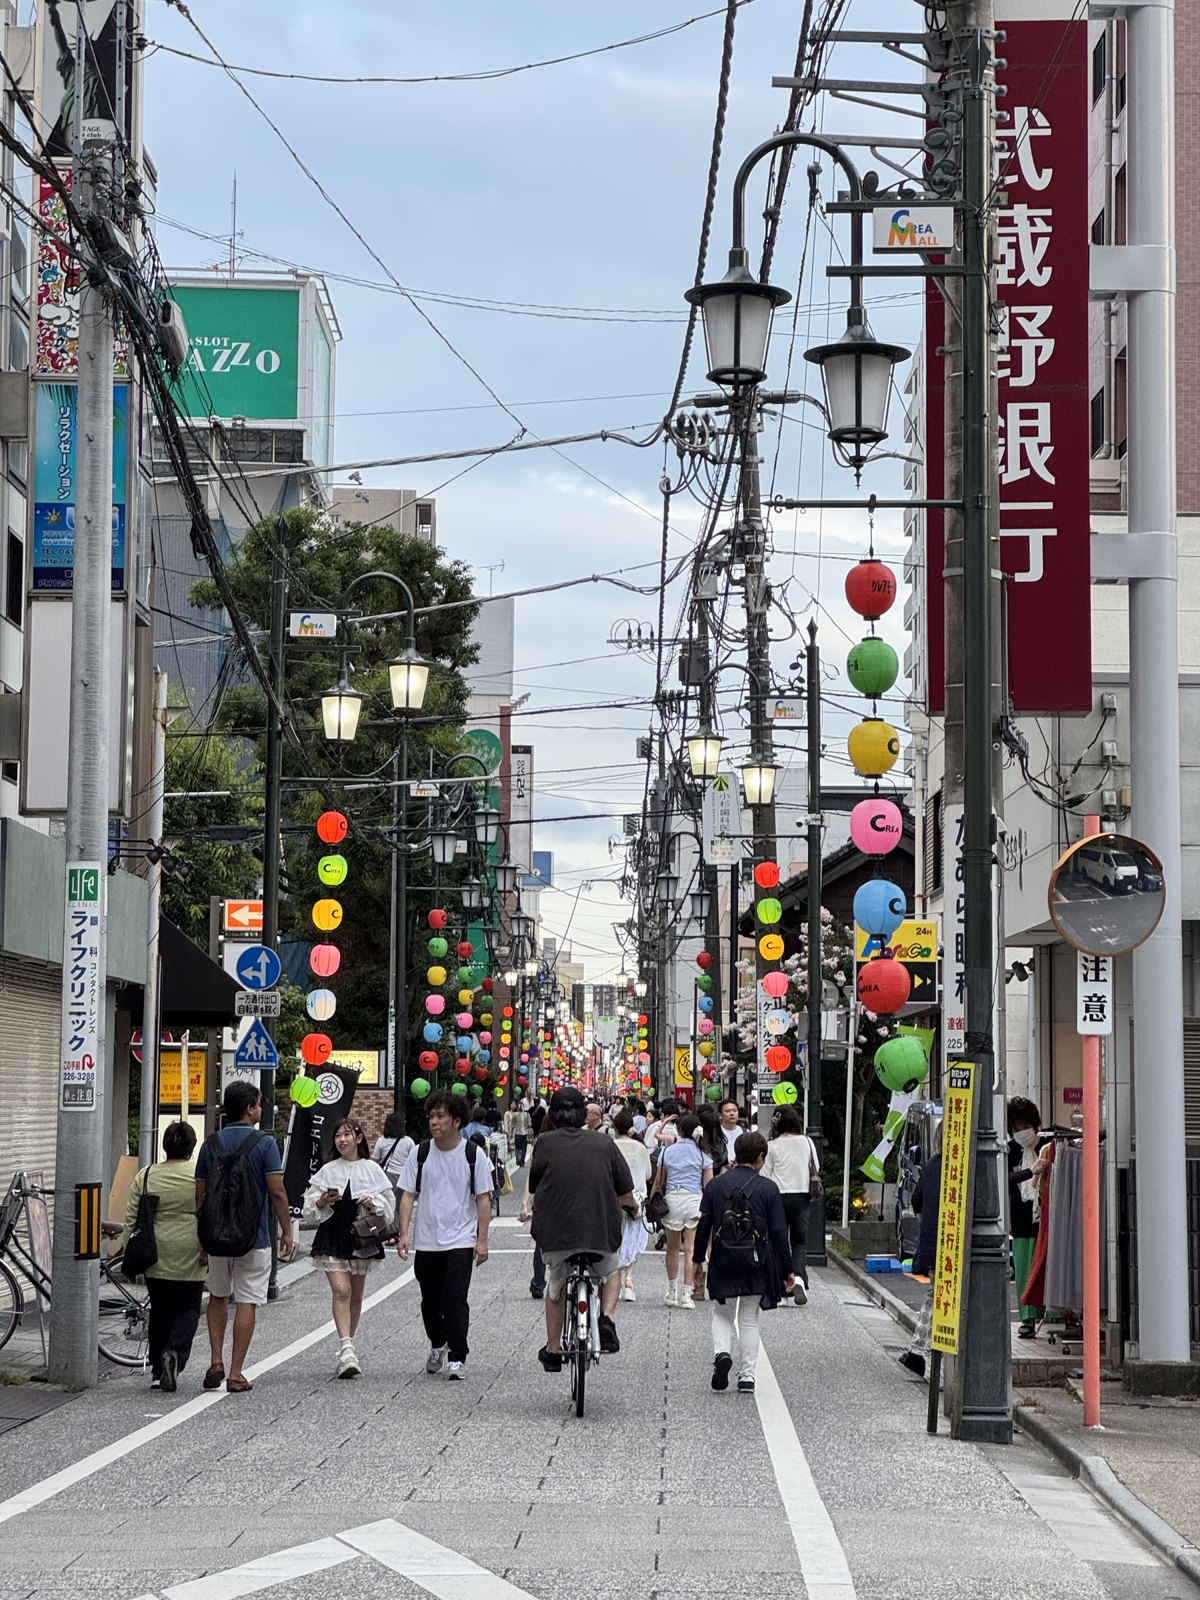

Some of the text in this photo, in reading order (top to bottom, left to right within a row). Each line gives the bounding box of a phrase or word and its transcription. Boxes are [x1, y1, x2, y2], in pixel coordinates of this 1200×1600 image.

[892, 209, 933, 233] CREA
[888, 223, 939, 246] MALL
[195, 336, 230, 347] SLOT
[58, 406, 72, 500] リラクゼーション
[870, 814, 900, 834] CREA
[915, 927, 932, 936] 24H
[67, 911, 88, 1051] ライフクリニック
[1081, 956, 1109, 1023] 注意
[88, 962, 97, 1034] コンタクトレンズ
[238, 994, 277, 1005] 一方通行出口
[238, 1004, 277, 1015] 自転車を除く
[63, 1072, 95, 1080] 226-3288
[942, 1097, 963, 1317] 客引きは違法行為です
